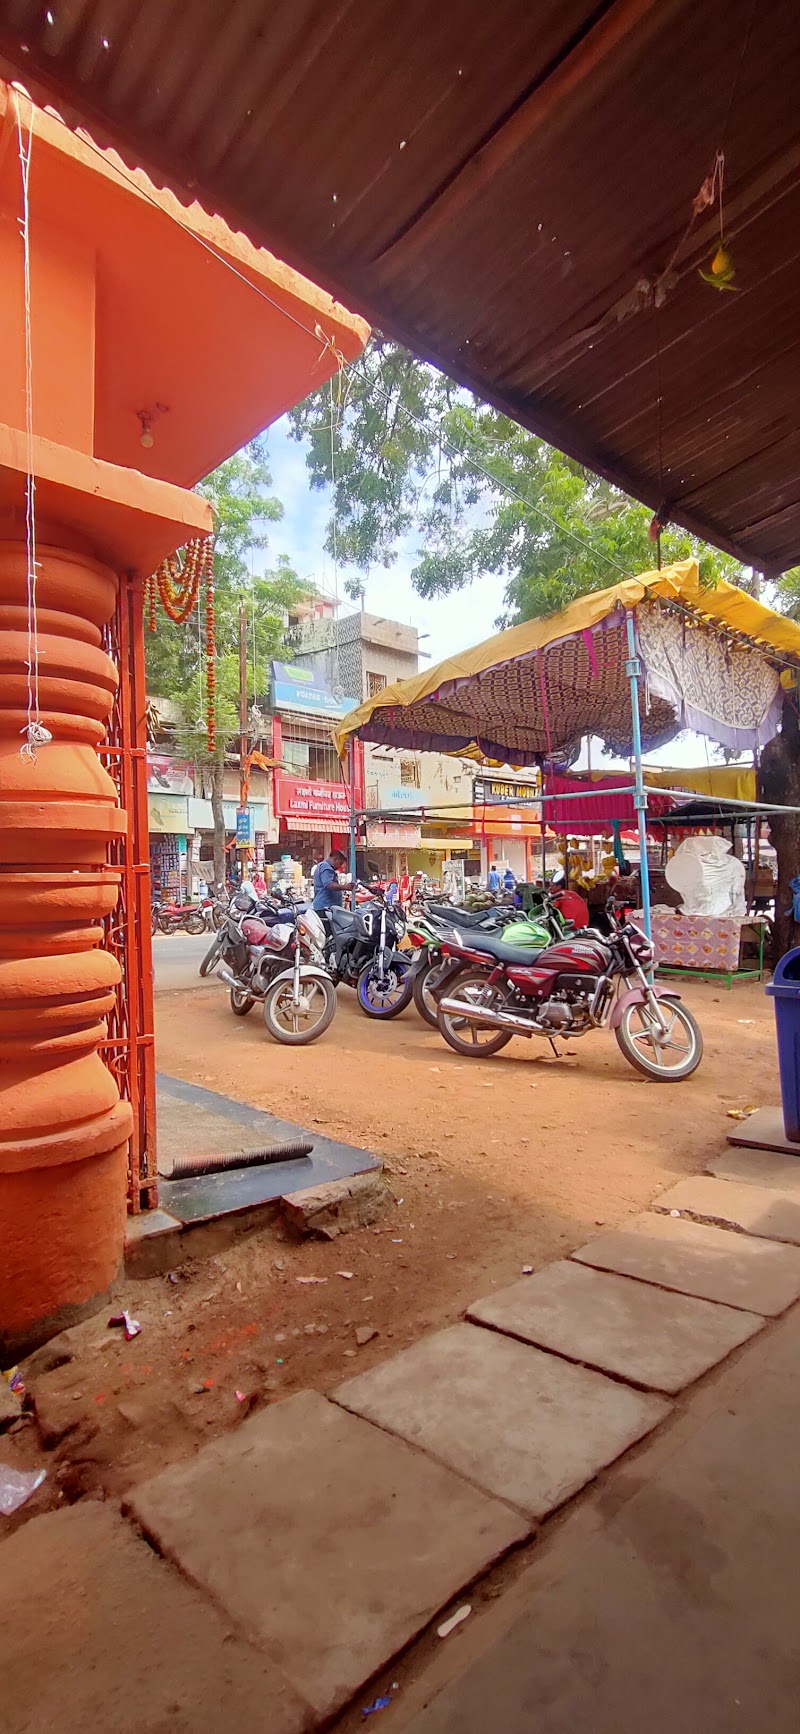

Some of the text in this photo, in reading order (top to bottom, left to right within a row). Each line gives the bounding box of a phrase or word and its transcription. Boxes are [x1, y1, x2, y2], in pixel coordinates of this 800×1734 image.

[296, 690, 320, 701] VOLTAS
[491, 783, 514, 797] KUBER
[290, 799, 352, 812] Laxmi Furniture Hous
